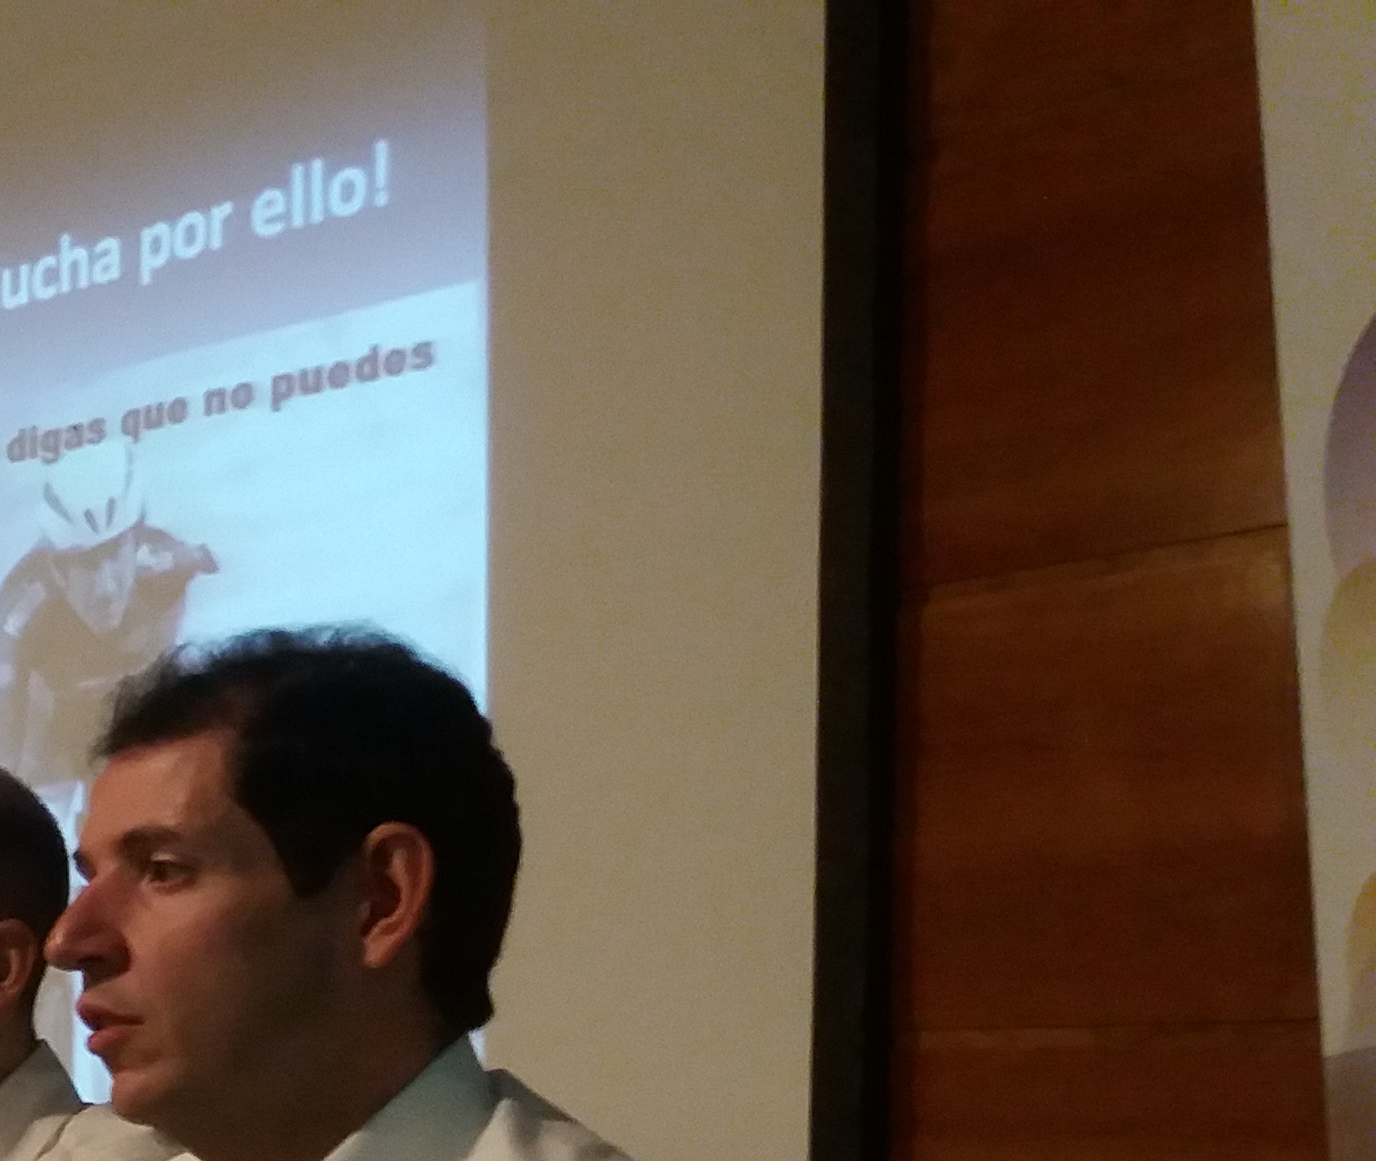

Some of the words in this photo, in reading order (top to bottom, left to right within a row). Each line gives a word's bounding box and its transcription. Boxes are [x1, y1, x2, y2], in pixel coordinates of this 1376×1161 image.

[139, 204, 233, 286] por
[249, 140, 392, 238] ello!
[6, 411, 107, 467] digas
[121, 397, 188, 446] que
[203, 379, 255, 419] no
[270, 337, 437, 415] puedes
